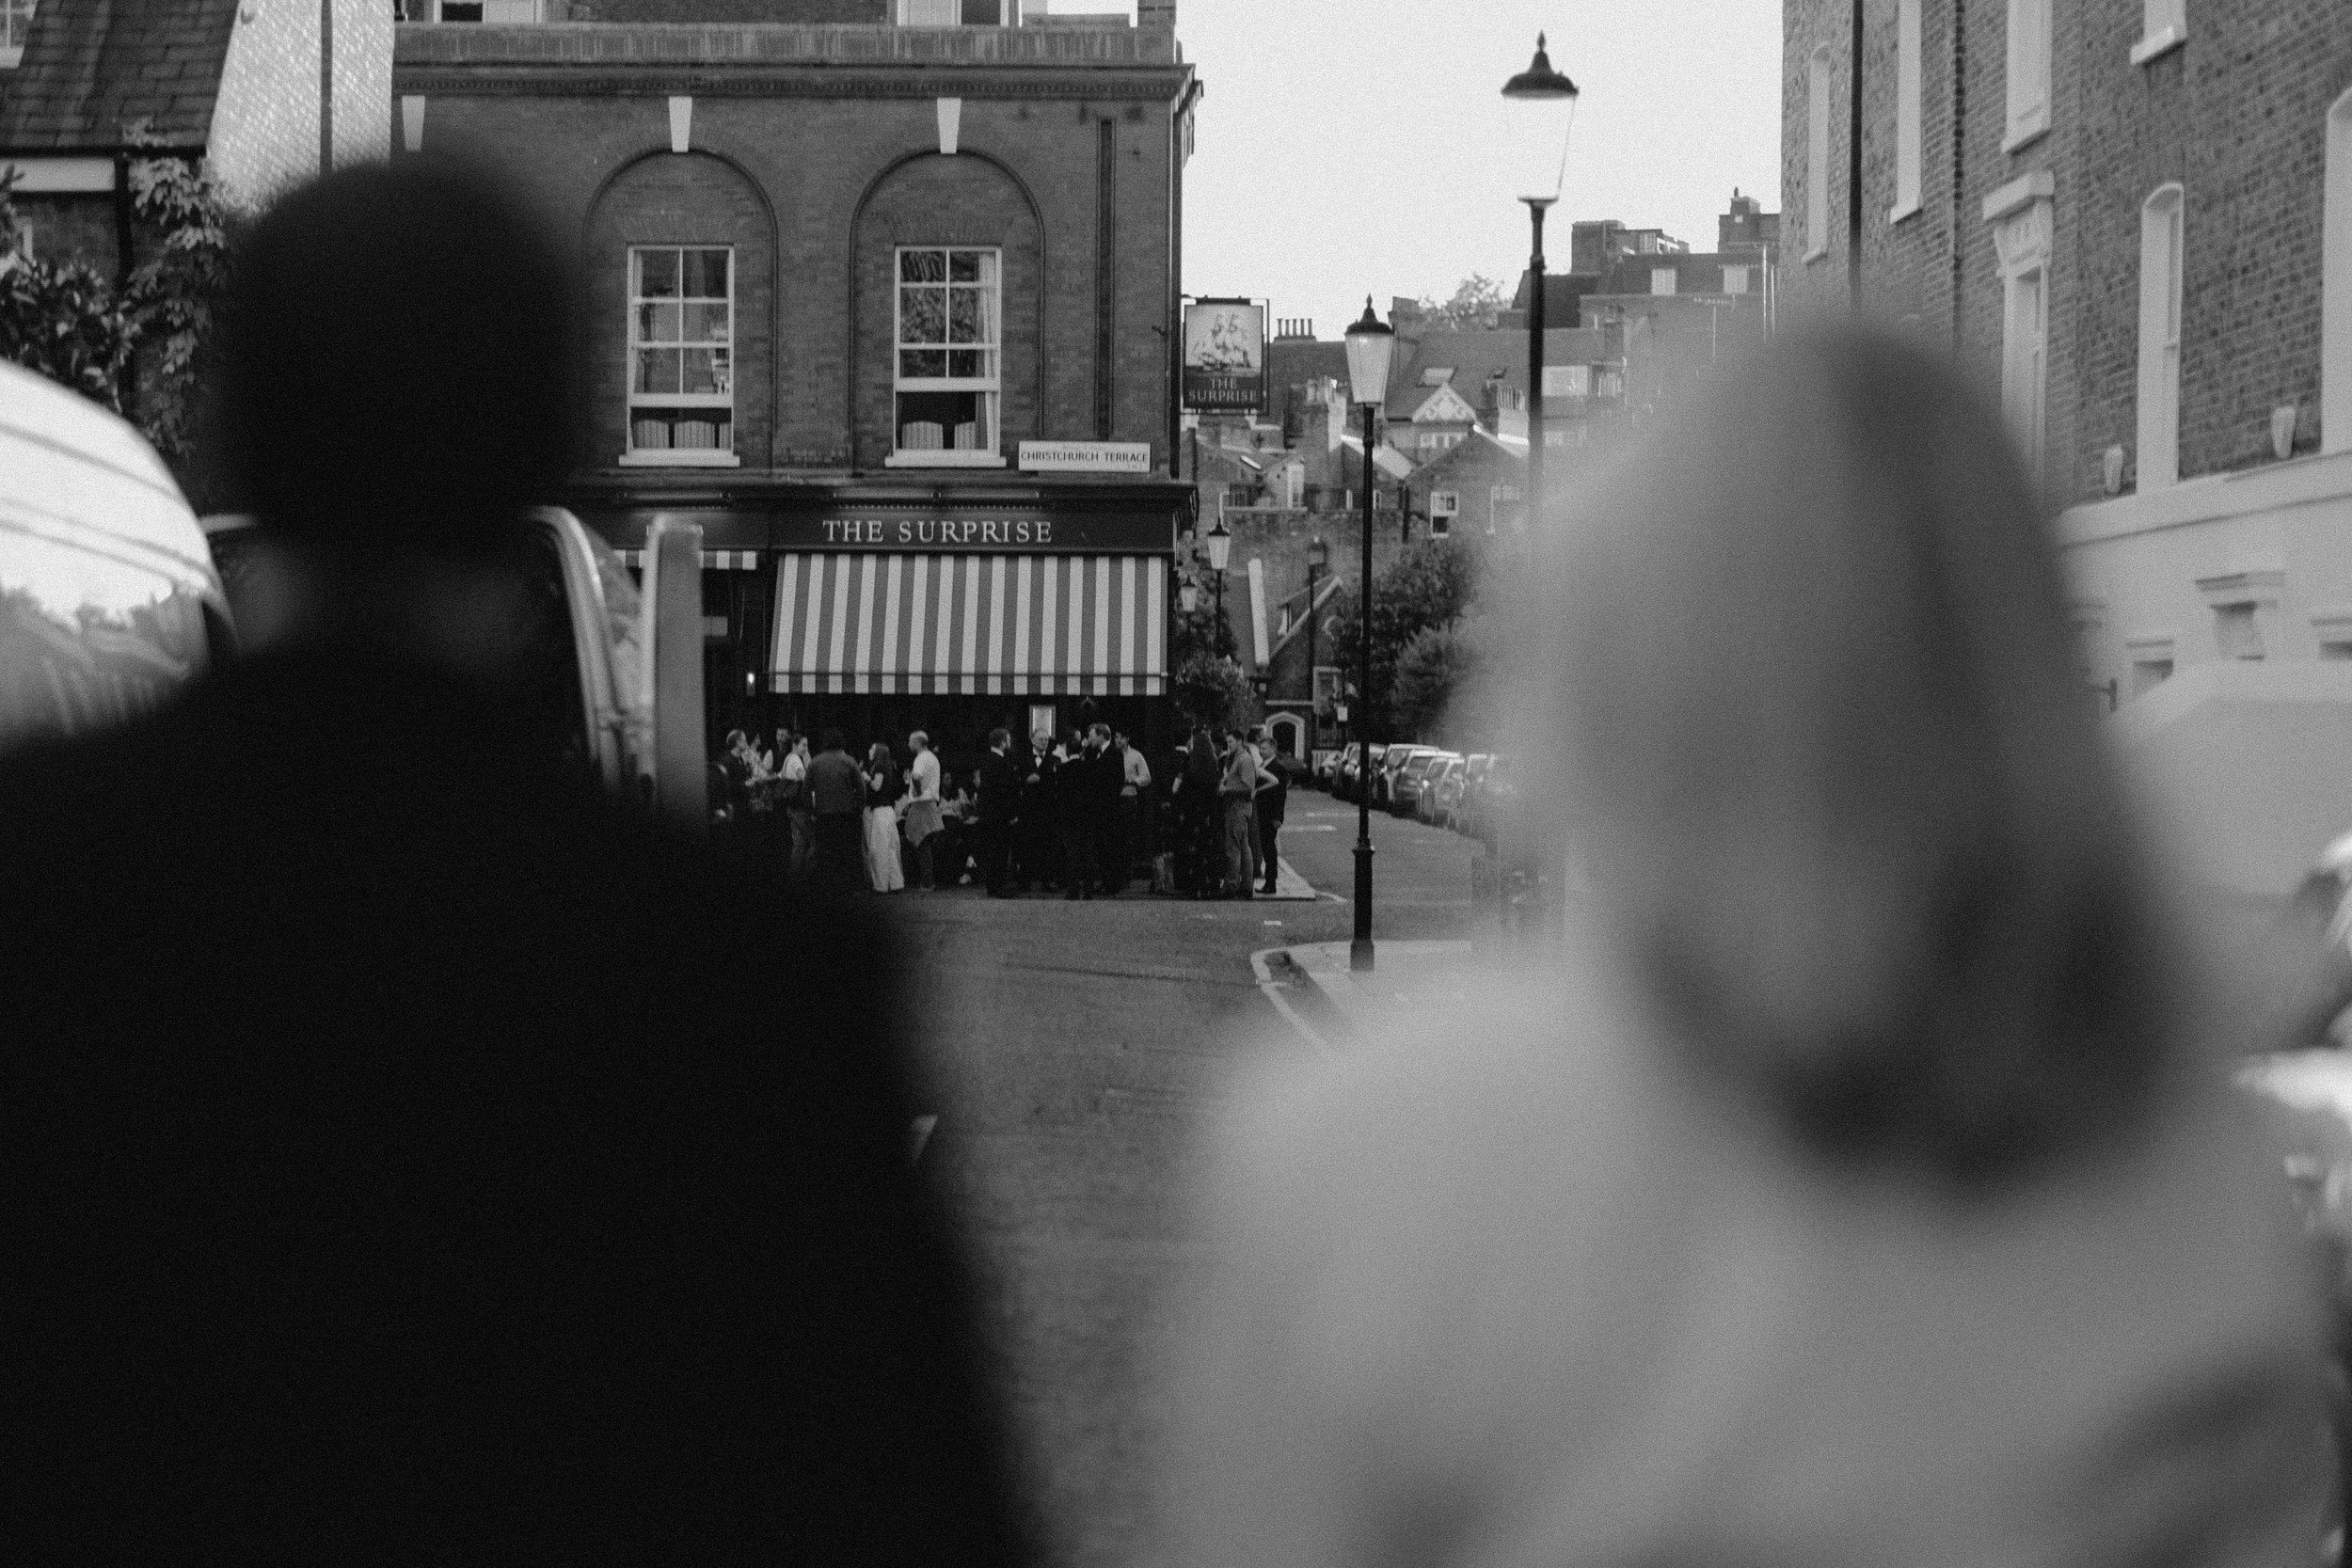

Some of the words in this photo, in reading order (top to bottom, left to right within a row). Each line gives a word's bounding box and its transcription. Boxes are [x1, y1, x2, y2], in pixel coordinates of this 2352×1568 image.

[1210, 377, 1238, 389] THE
[1189, 389, 1257, 403] SURPRISE
[1021, 451, 1100, 462] CHRISTCHURCH
[1104, 451, 1147, 463] TERRACE
[823, 520, 884, 543] THE
[898, 520, 1052, 544] SURPRISE
